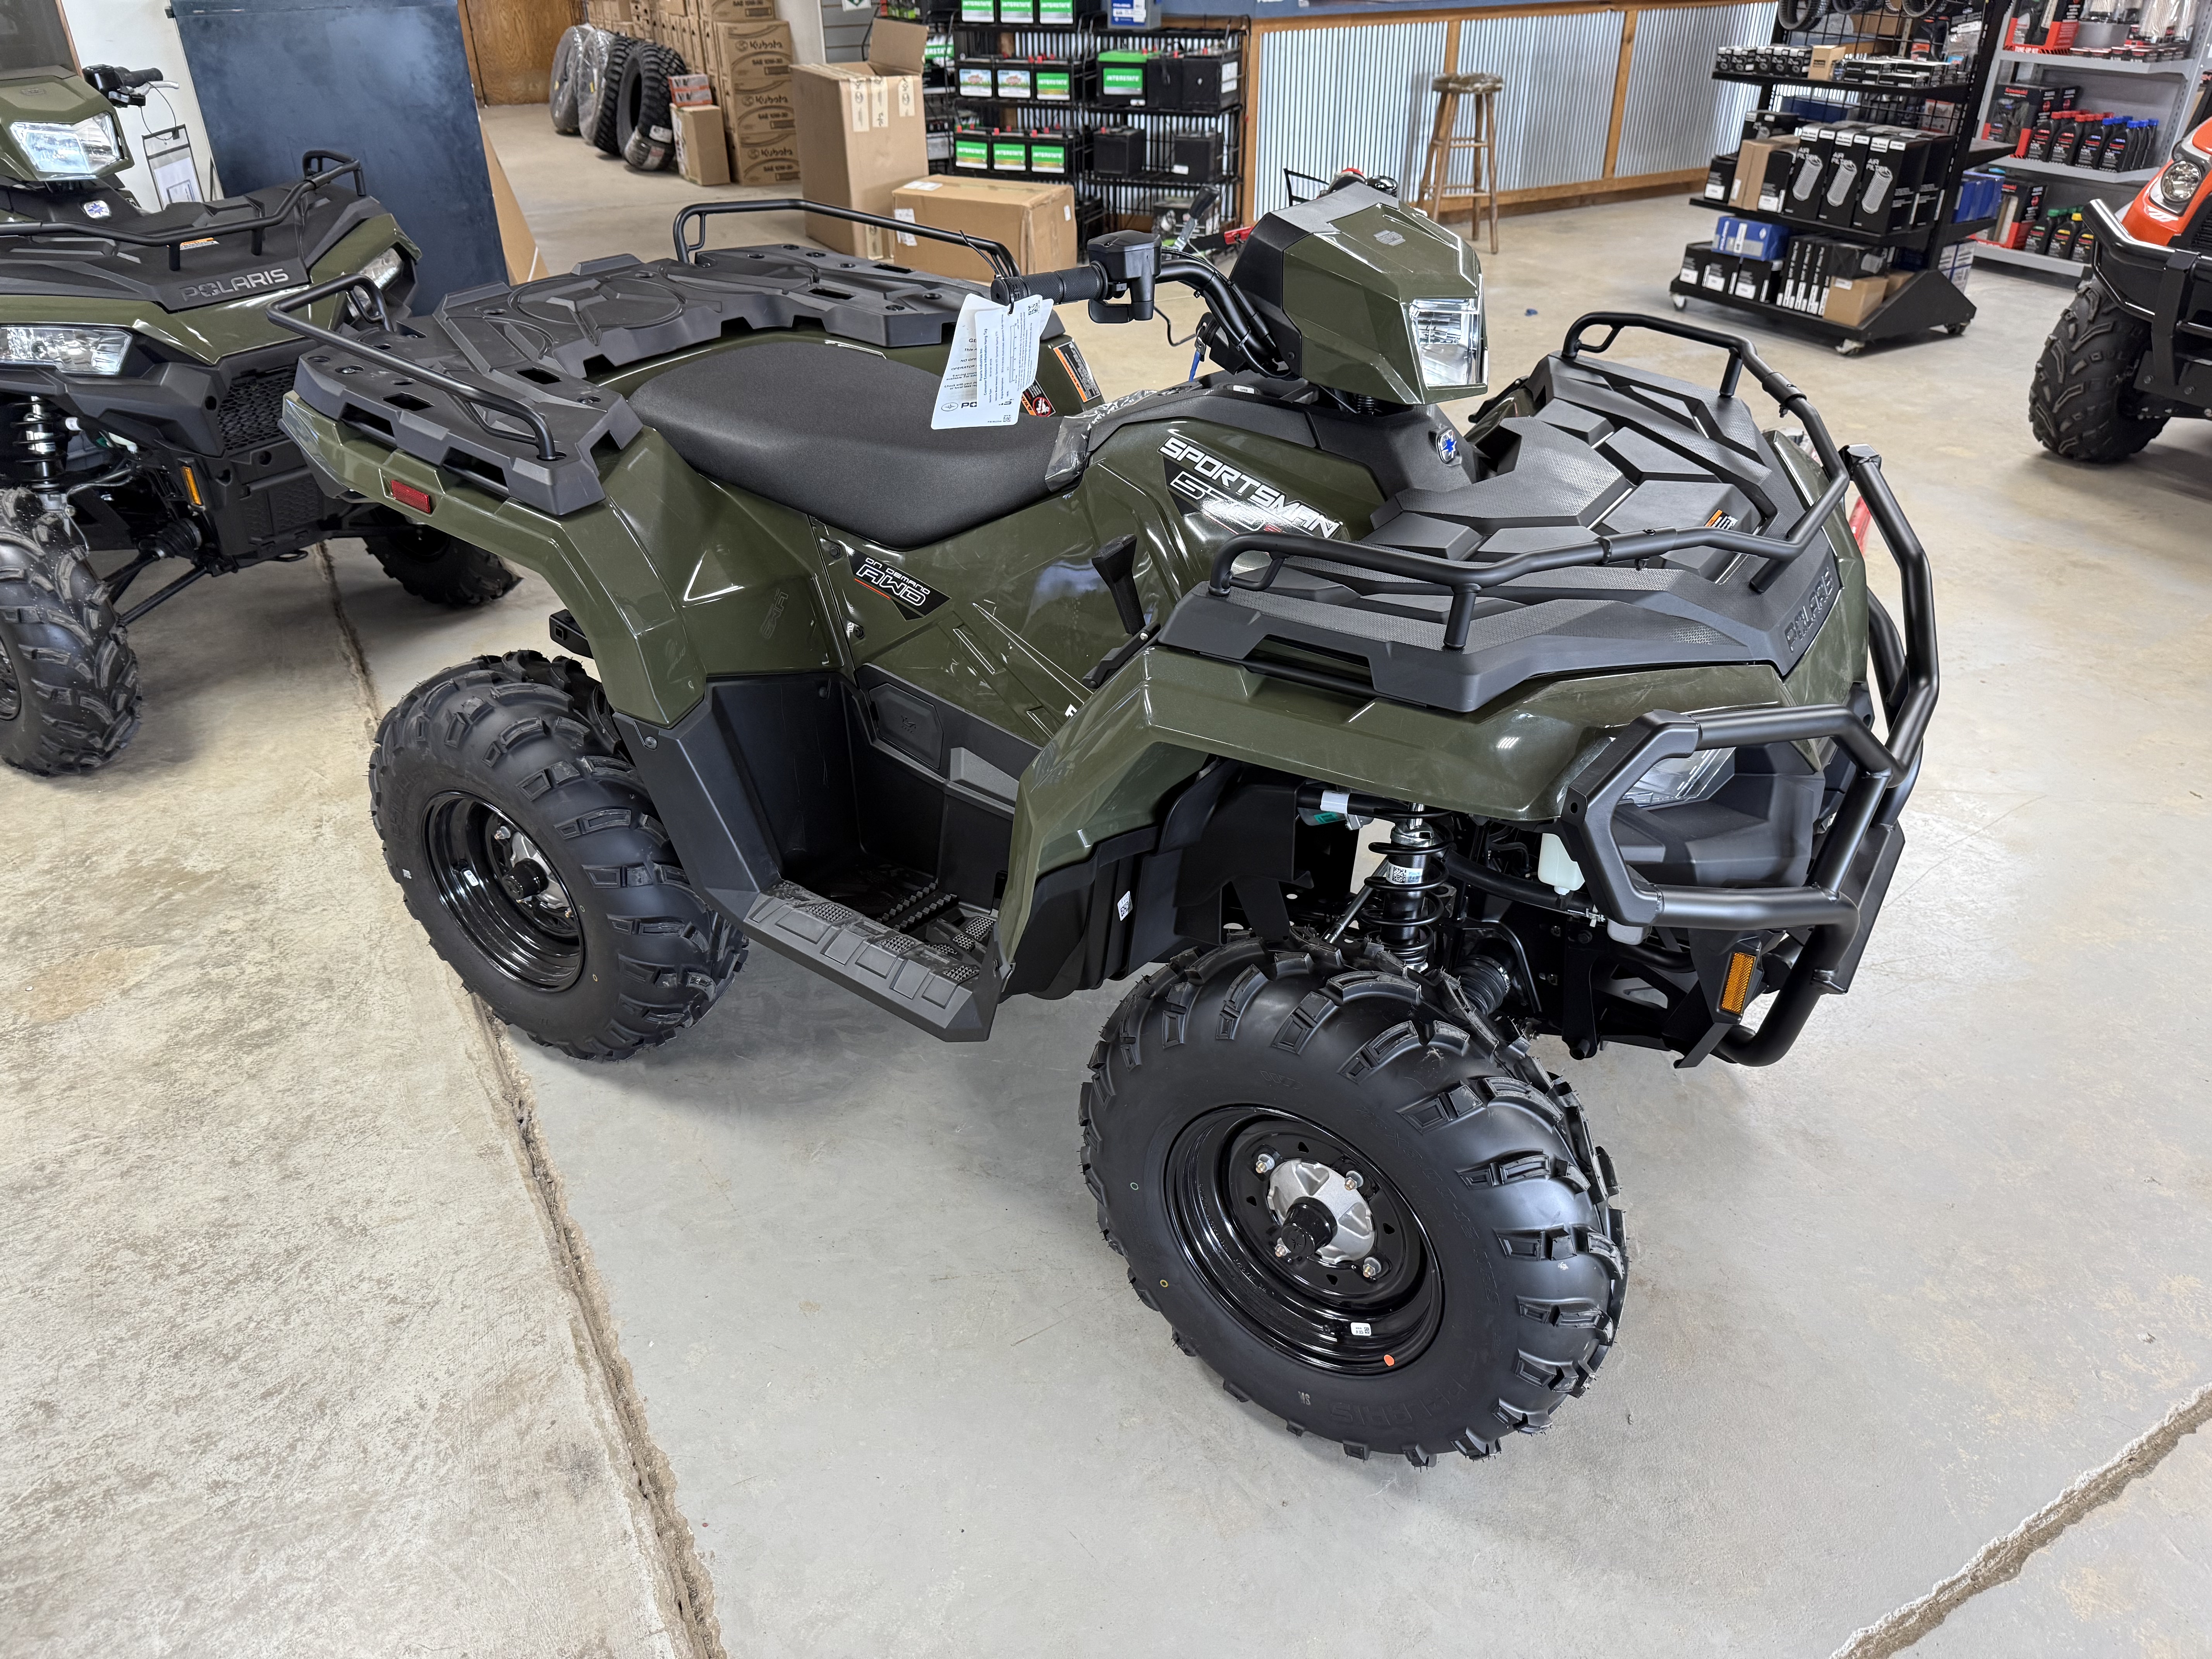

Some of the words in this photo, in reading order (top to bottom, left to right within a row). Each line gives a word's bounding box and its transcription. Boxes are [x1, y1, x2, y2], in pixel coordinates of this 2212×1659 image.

[749, 40, 783, 50] Kubota
[756, 94, 788, 105] Kubota
[761, 146, 793, 157] Kubota
[179, 268, 289, 302] POLARIS
[1160, 436, 1341, 539] SPORTSMAN
[855, 564, 926, 606] AWD
[865, 557, 883, 568] ON
[885, 568, 931, 595] DEMAND
[1784, 567, 1834, 653] POLARIS
